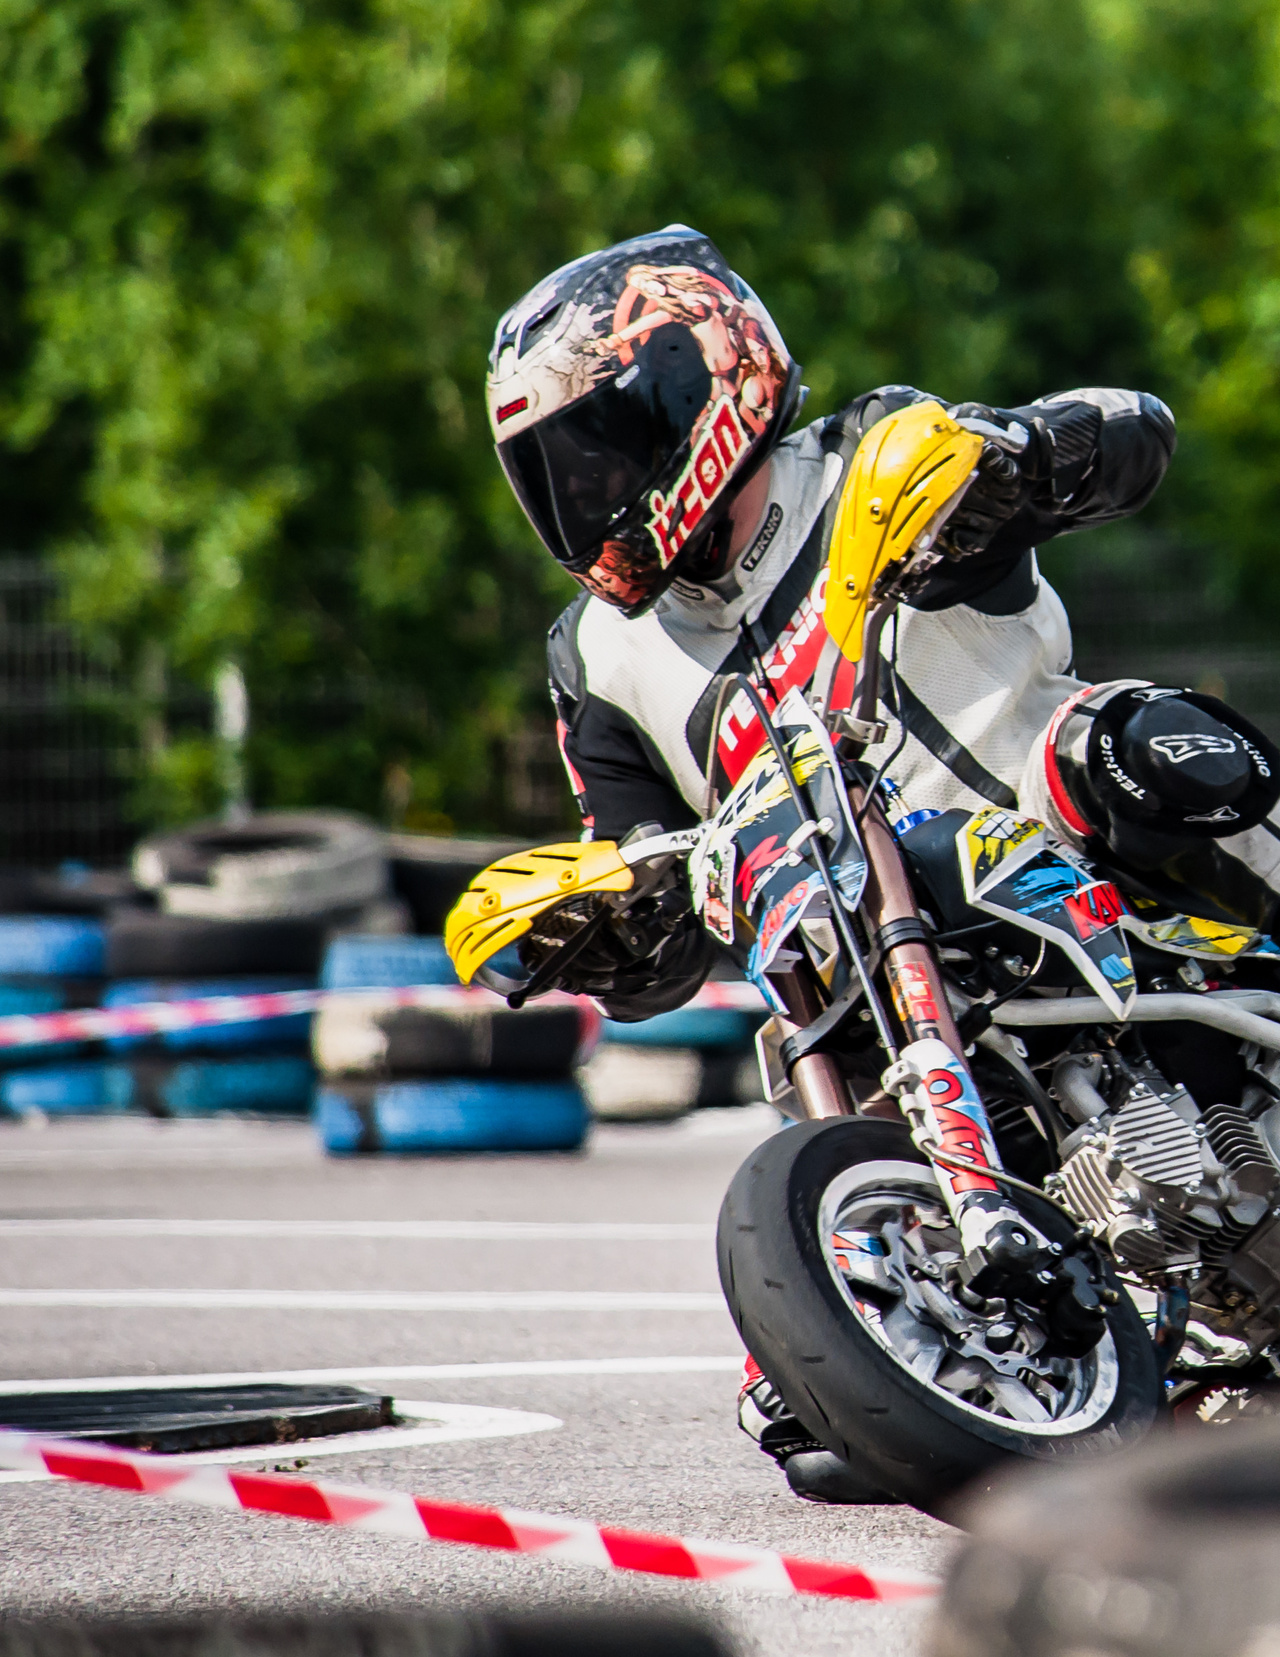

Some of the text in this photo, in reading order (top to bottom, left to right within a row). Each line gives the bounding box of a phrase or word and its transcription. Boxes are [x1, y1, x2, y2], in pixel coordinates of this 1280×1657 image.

[743, 504, 782, 570] TEKNIC
[1099, 733, 1147, 800] TEKNIC
[922, 1067, 999, 1195] KAYO
